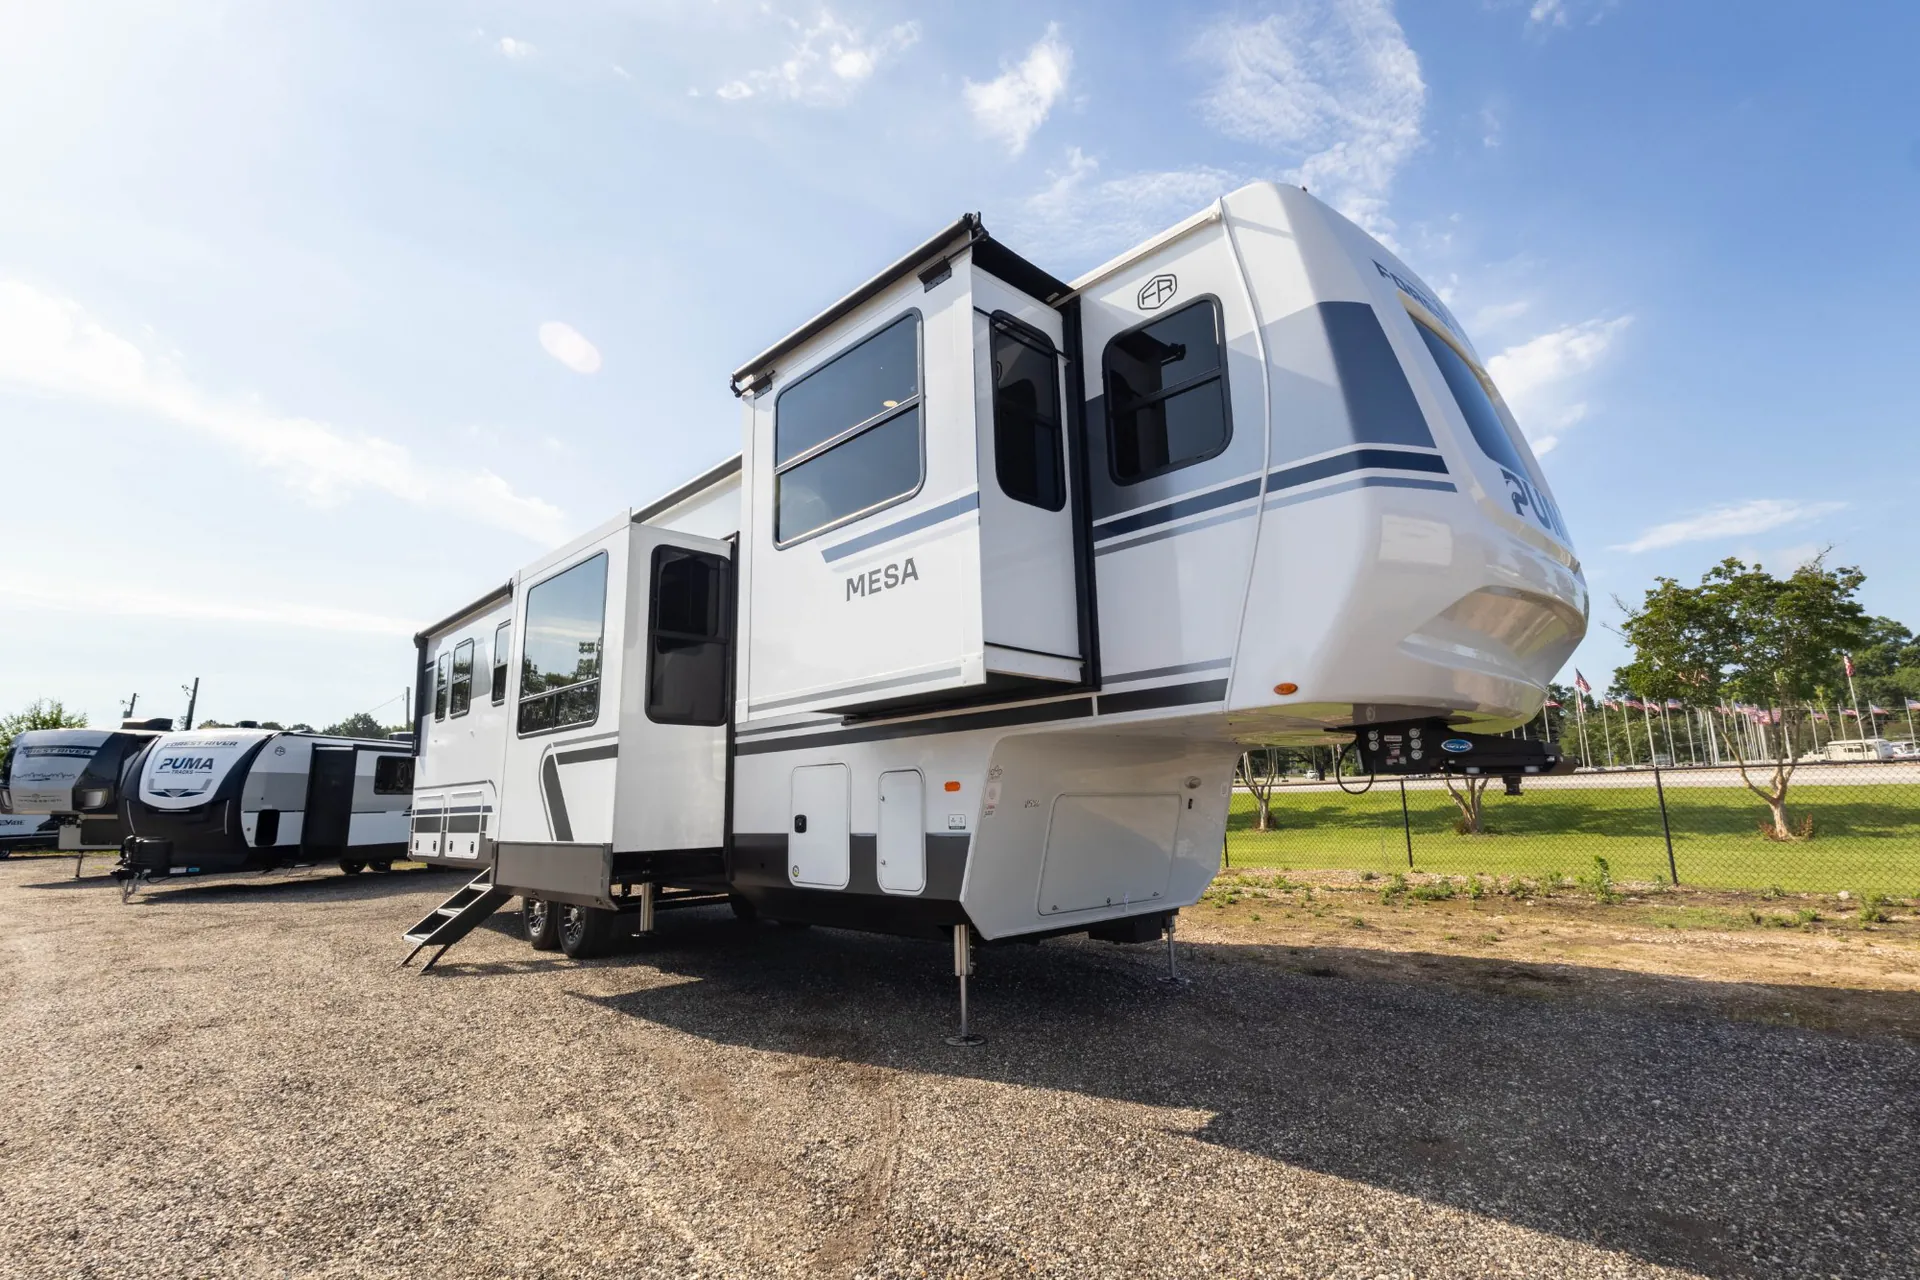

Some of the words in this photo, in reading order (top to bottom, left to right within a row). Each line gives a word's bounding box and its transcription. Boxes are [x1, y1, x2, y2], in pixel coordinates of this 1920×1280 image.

[1500, 467, 1573, 548] PUM
[846, 557, 919, 602] MESA
[165, 740, 202, 748] FOREST
[159, 757, 214, 770] PUMA
